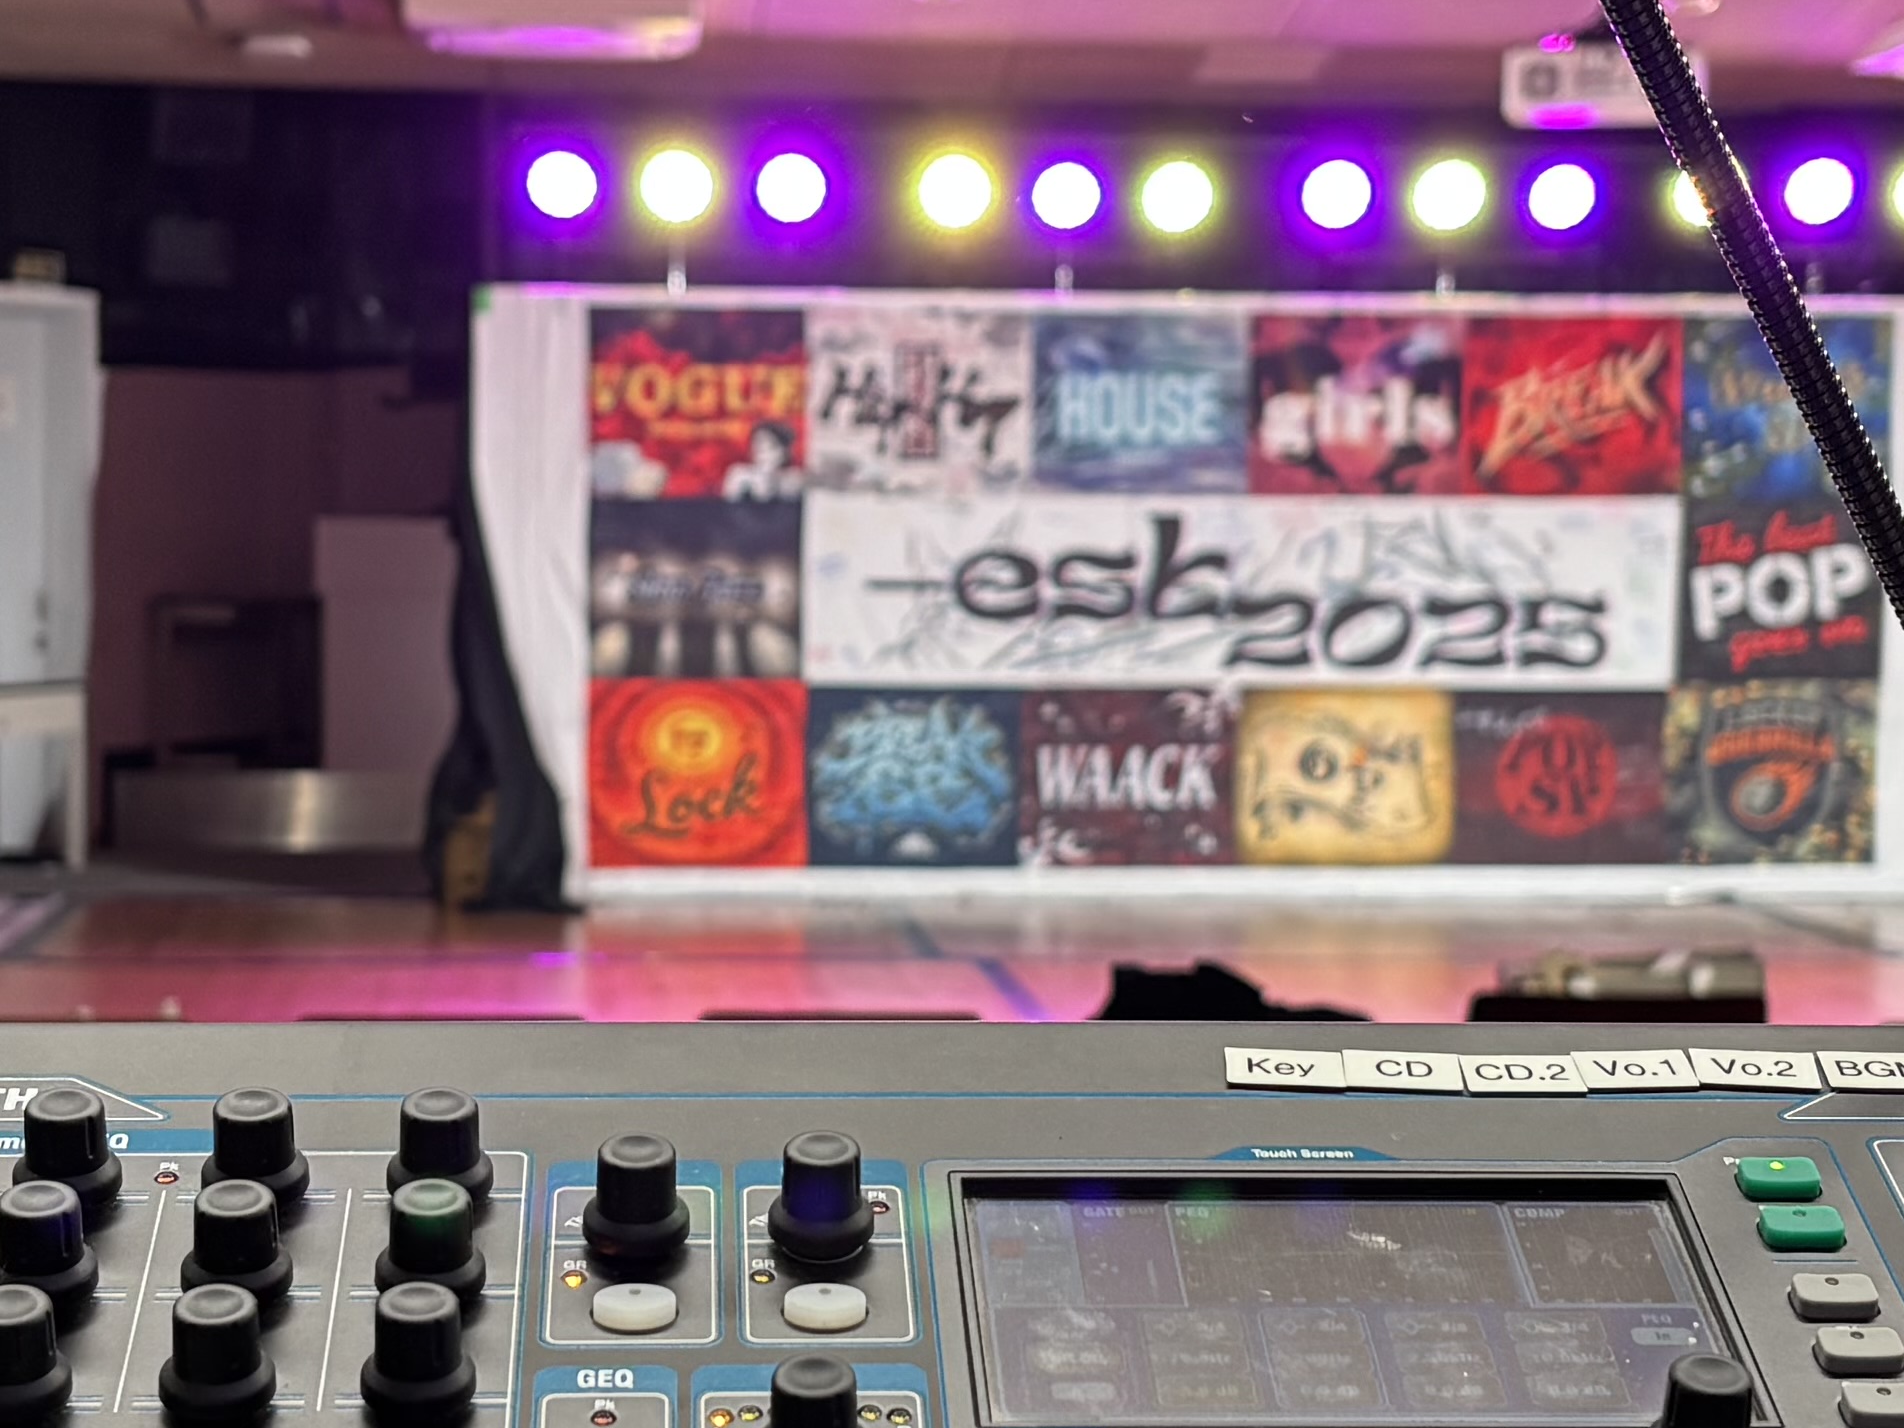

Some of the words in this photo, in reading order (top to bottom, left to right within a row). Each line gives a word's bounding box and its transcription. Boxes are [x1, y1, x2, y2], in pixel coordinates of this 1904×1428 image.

[591, 361, 806, 419] VOGUE
[1057, 371, 1219, 443] HOUSE
[1478, 333, 1667, 477] BREAK
[1261, 374, 1457, 460] girls
[1690, 543, 1871, 642] POP
[1227, 594, 1607, 669] 2025
[1036, 742, 1221, 812] WAACK
[626, 756, 761, 839] Lock
[1247, 1057, 1315, 1078] Key
[1375, 1059, 1433, 1078] CD
[1474, 1063, 1566, 1081] CD.2
[1593, 1059, 1676, 1077] Vo.1
[1710, 1057, 1796, 1077] Vo.2
[1251, 1148, 1298, 1158] Touch
[1300, 1148, 1354, 1159] Screen
[1514, 1208, 1565, 1220] COMP
[563, 1259, 588, 1271] GR
[751, 1258, 776, 1270] GR
[576, 1368, 634, 1389] GEQ
